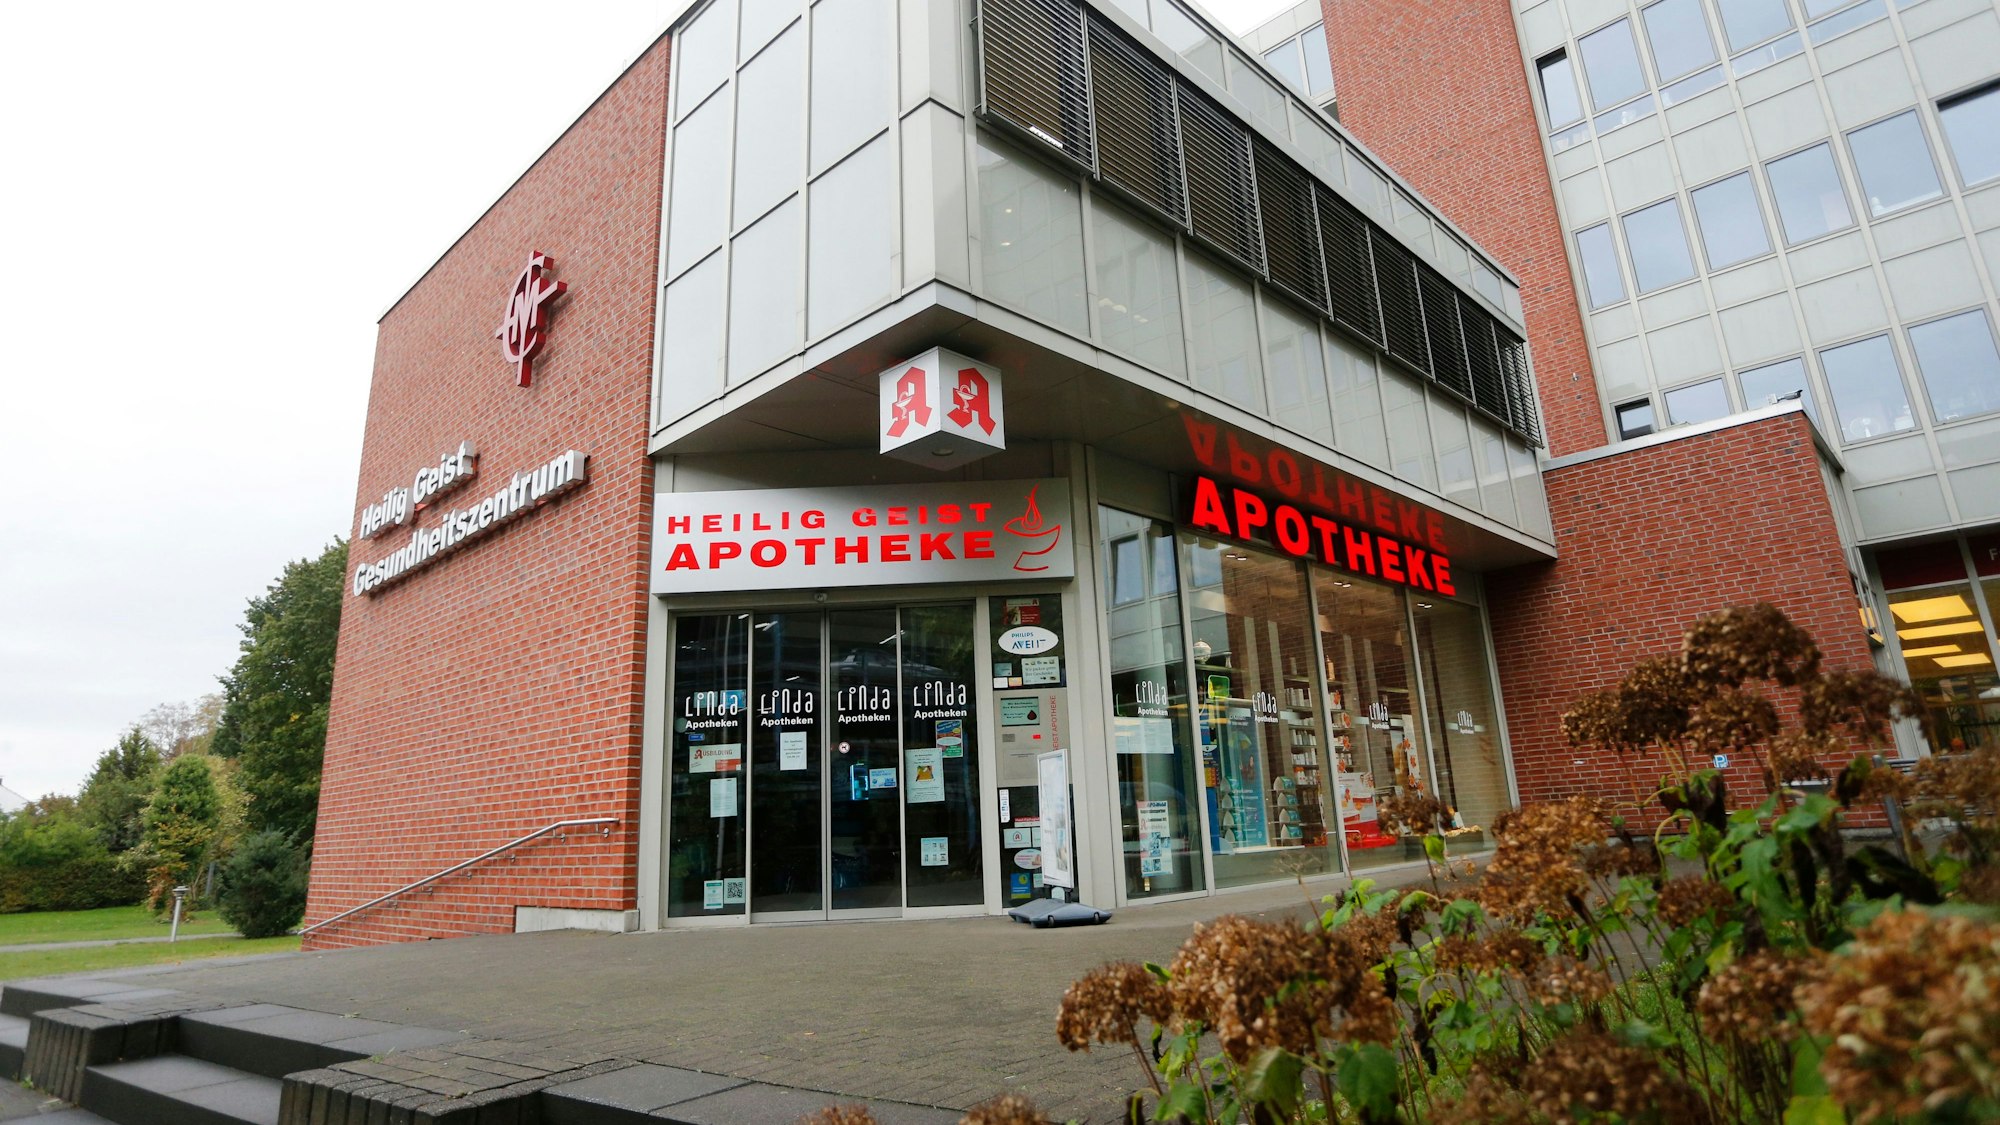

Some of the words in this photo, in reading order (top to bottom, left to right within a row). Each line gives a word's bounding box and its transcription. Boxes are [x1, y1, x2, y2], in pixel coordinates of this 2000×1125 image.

[887, 366, 933, 438] A
[947, 367, 996, 437] A
[359, 486, 412, 540] Heilig
[412, 440, 473, 504] Geist
[353, 449, 581, 597] Gesundheitszentrum
[667, 510, 826, 534] HEILIG
[851, 502, 992, 528] GEIST
[1191, 475, 1456, 597] APOTHEKE
[665, 530, 996, 571] APOTHEKE
[685, 719, 739, 730] Apotheken
[760, 716, 814, 728] Apotheken
[838, 712, 891, 724] Apotheken
[914, 708, 967, 720] Apotheken
[1137, 706, 1169, 716] Apotheken
